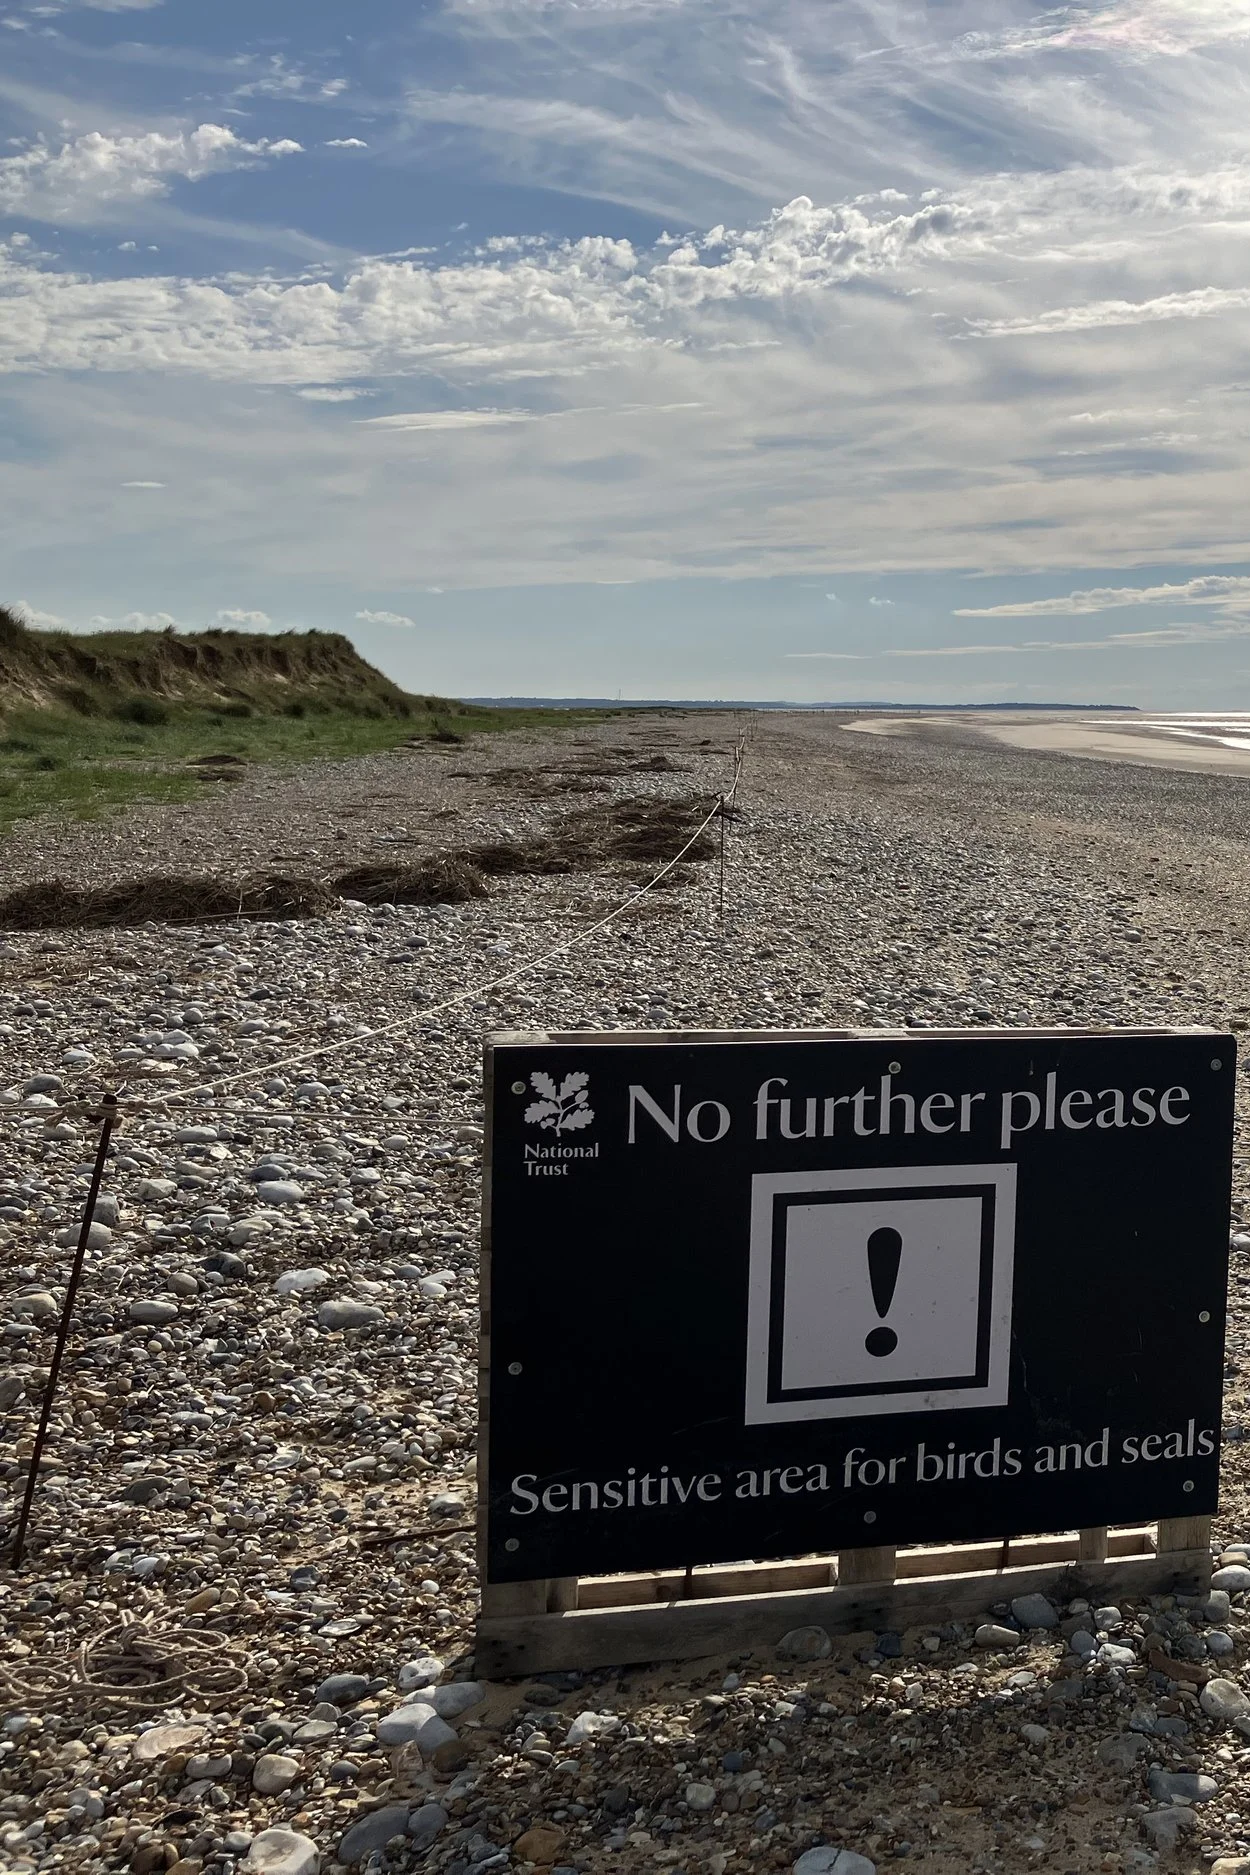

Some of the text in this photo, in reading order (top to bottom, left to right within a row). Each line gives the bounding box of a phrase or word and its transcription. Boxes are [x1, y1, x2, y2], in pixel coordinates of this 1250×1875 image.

[628, 1071, 1190, 1149] No further please
[523, 1160, 569, 1176] Trust
[524, 1142, 599, 1159] National
[510, 1418, 1215, 1515] Sensitive area for birds and seals
